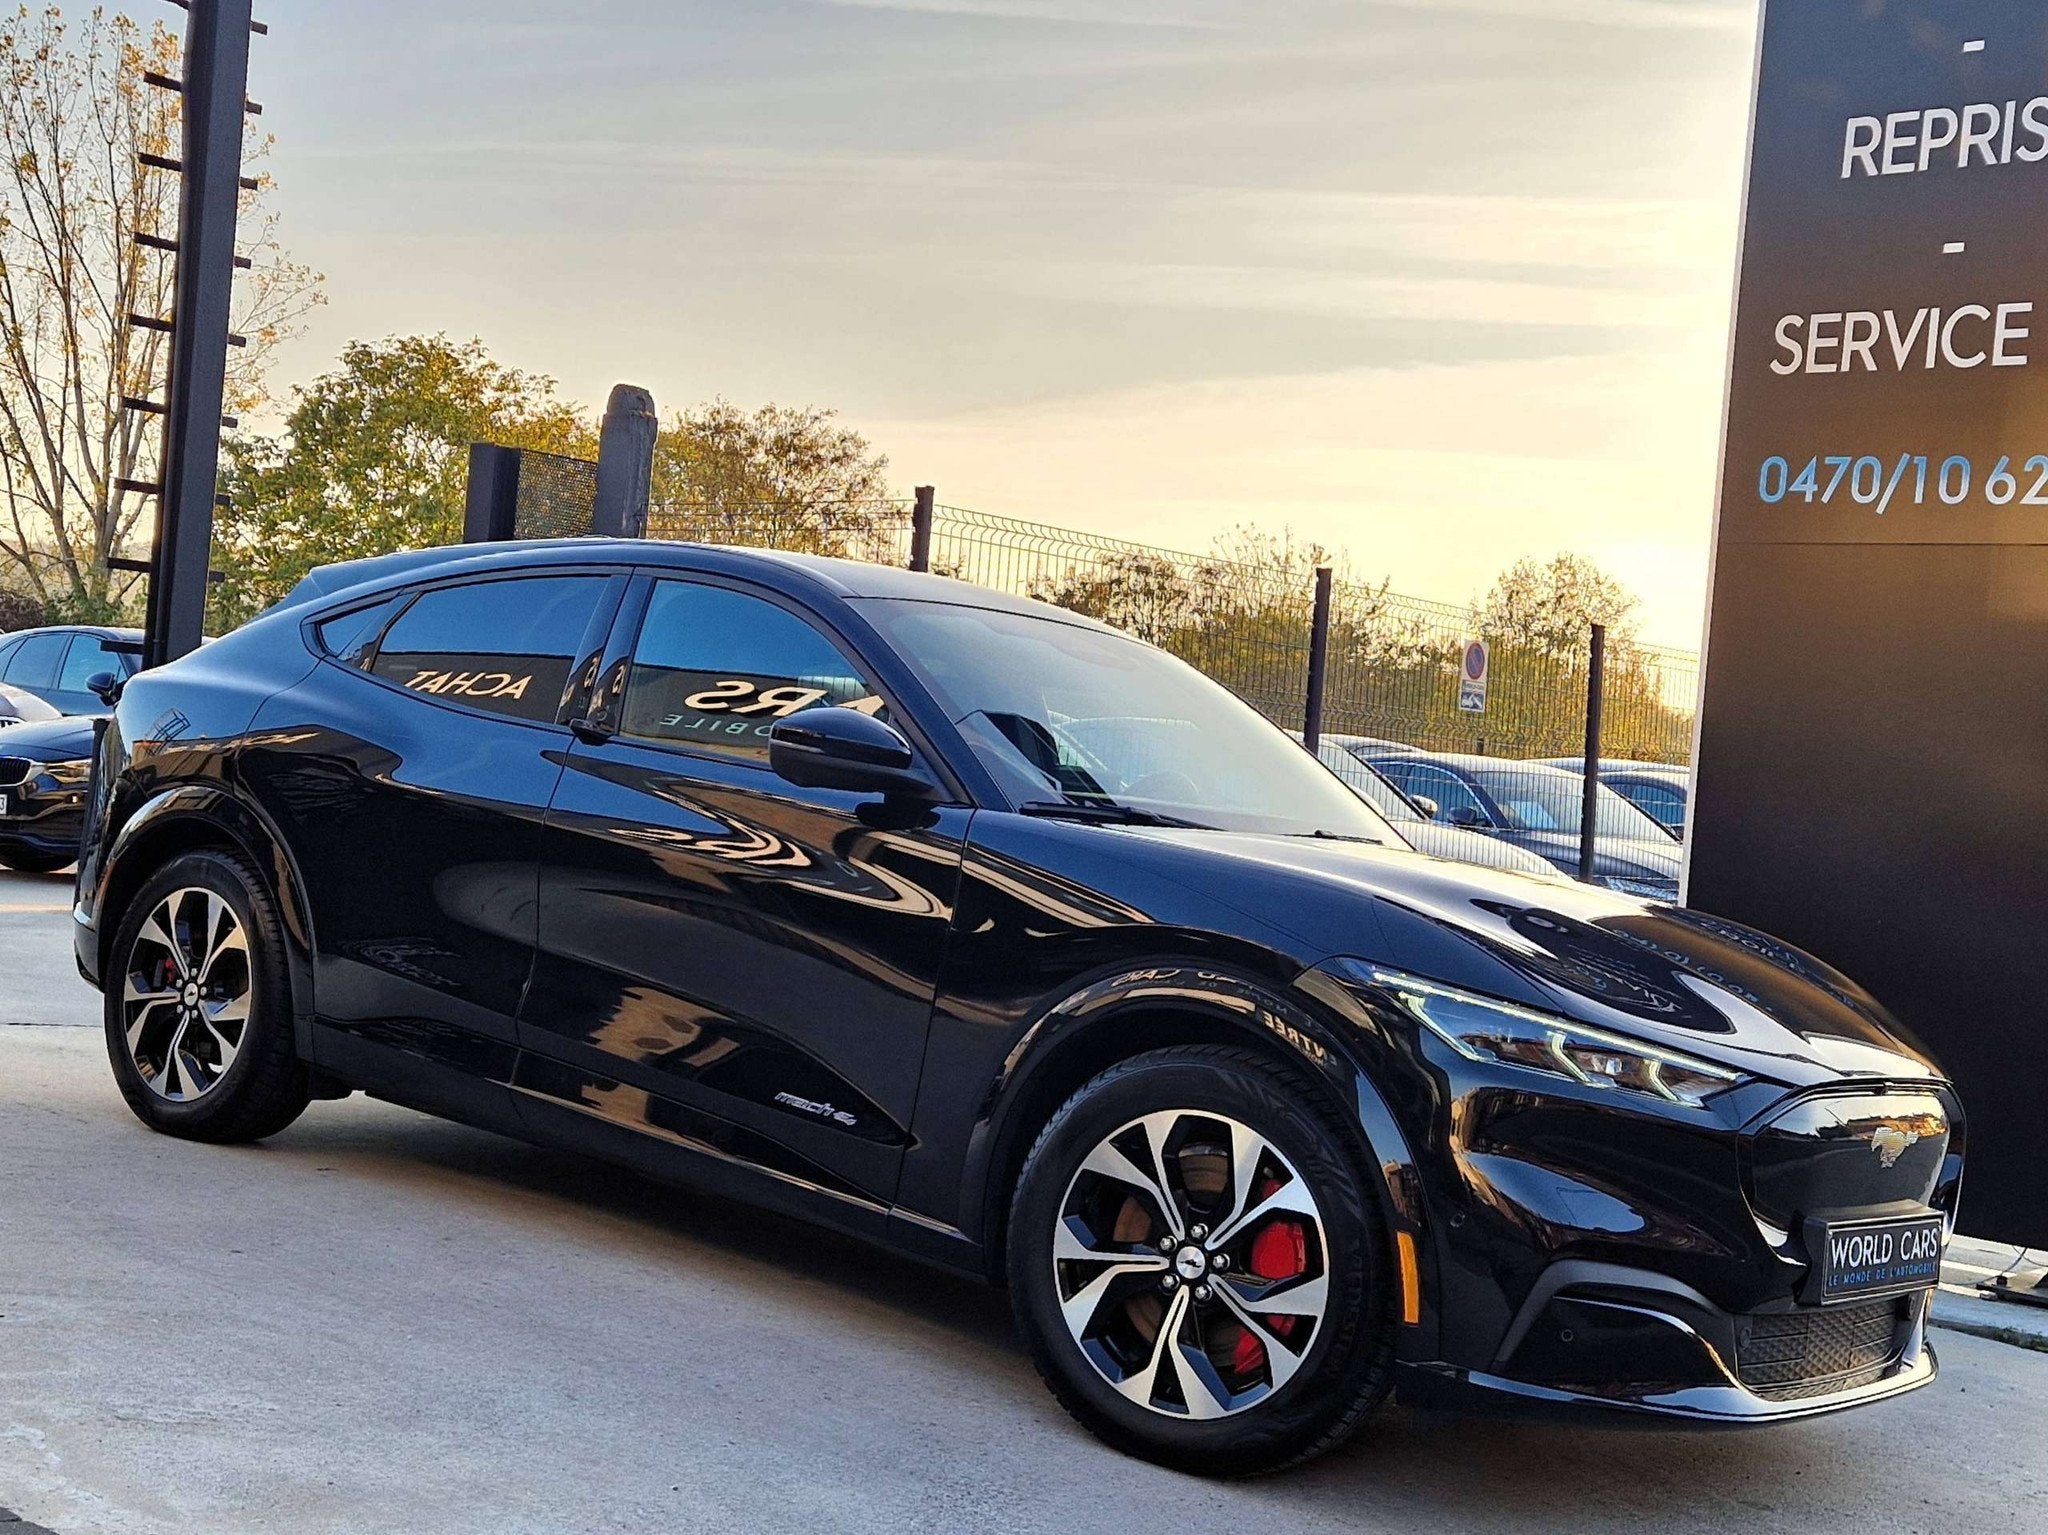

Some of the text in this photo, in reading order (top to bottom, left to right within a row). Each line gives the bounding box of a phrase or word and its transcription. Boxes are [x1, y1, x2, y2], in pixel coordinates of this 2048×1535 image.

[1840, 96, 2048, 178] REPRIS
[1770, 302, 2033, 375] SERVICE
[1758, 453, 2048, 514] 0470/10 62
[1828, 1275, 1838, 1287] LE
[1843, 1271, 1871, 1285] MONDE
[1876, 1267, 1886, 1280] DE
[1831, 1227, 1938, 1269] WORLD CARS
